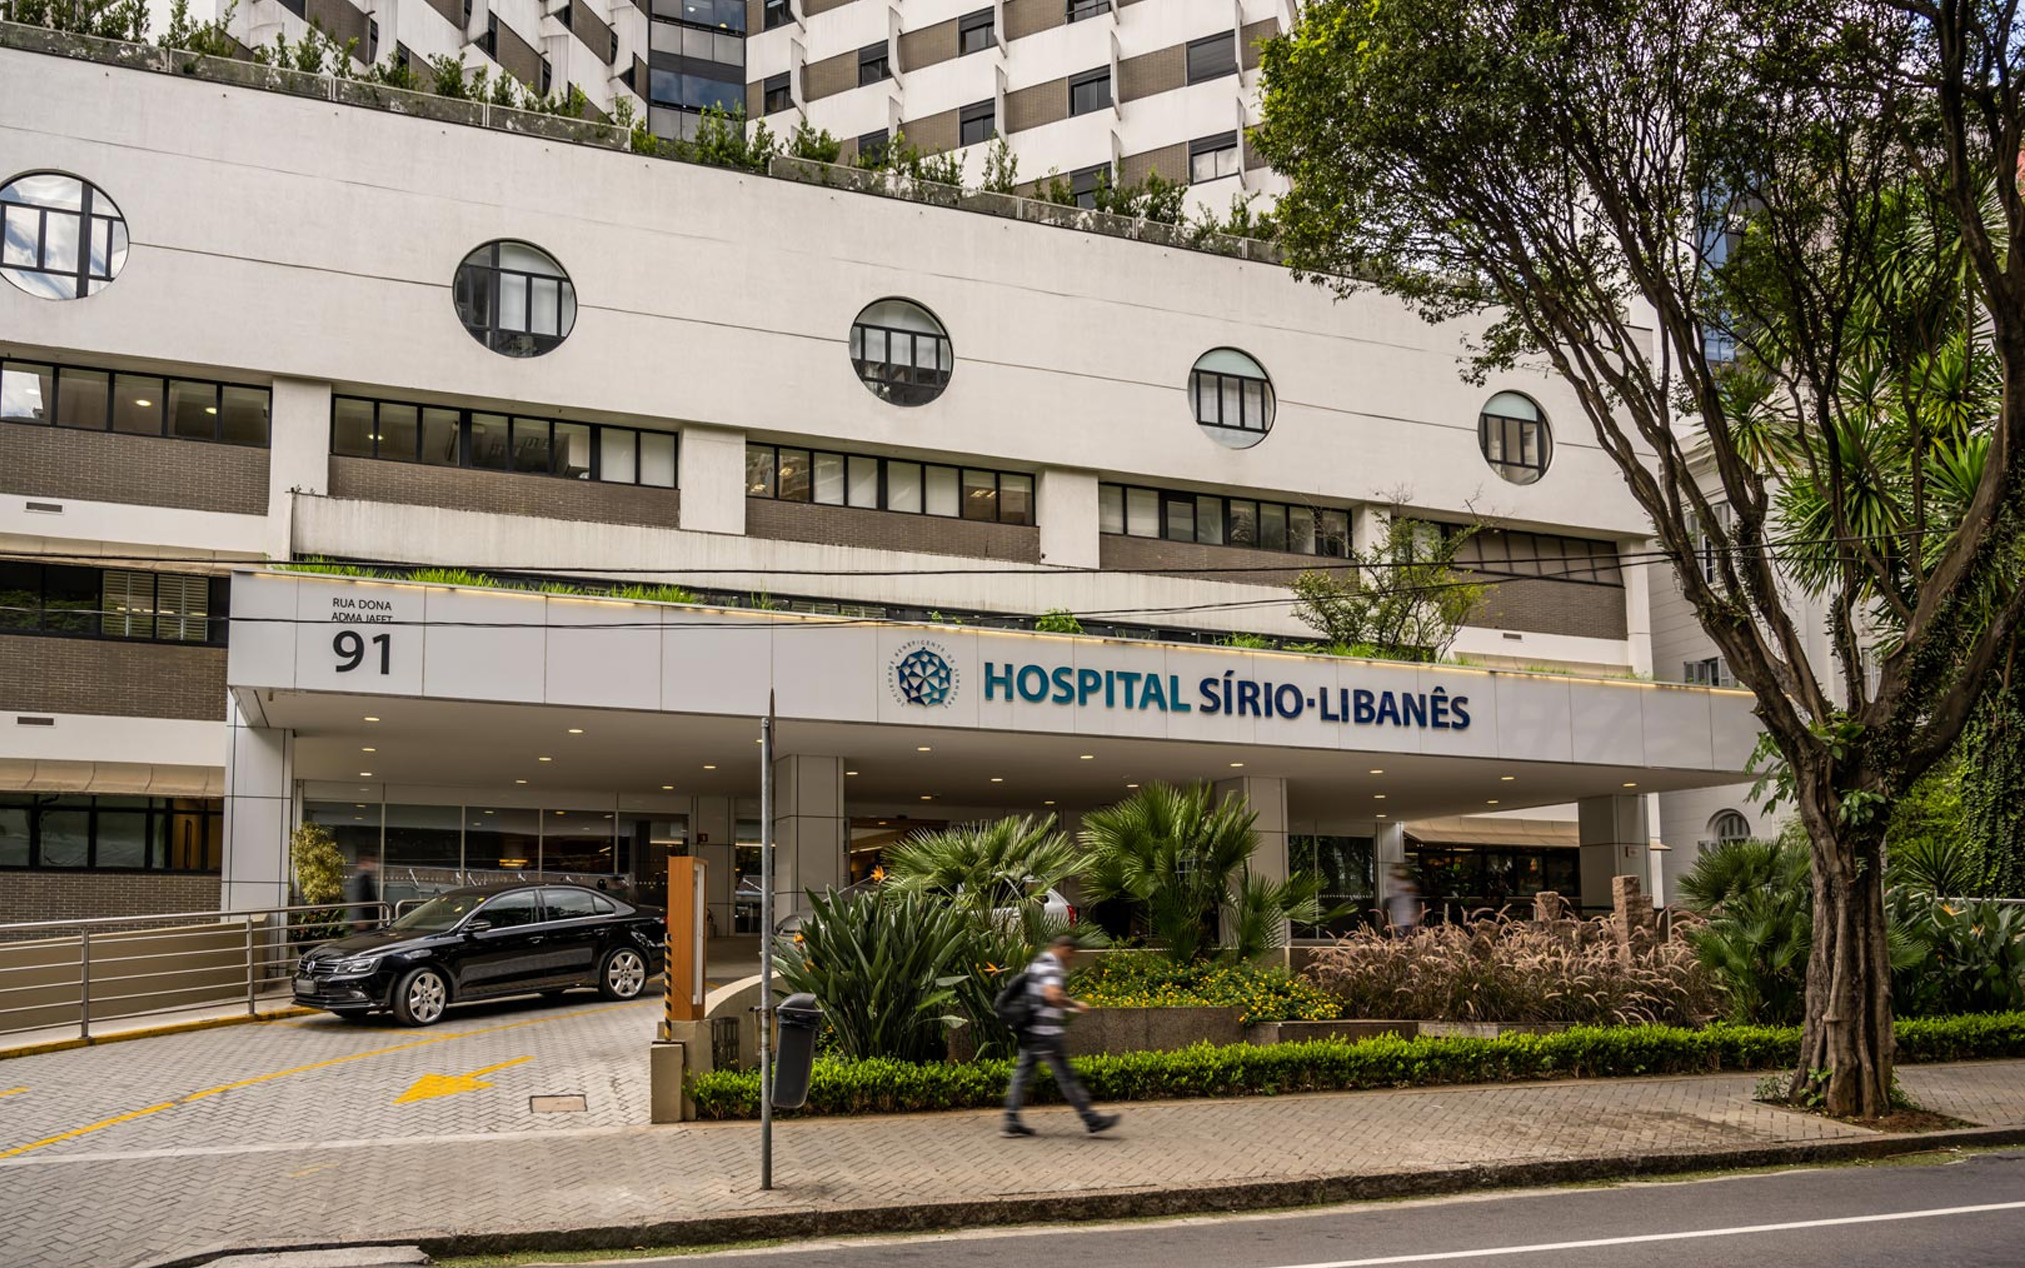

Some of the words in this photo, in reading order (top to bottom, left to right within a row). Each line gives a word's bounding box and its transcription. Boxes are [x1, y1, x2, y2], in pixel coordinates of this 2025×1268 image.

[331, 612, 362, 623] ADMA
[333, 597, 355, 608] RUA
[358, 600, 392, 611] DONA
[333, 630, 390, 675] 91
[984, 662, 1191, 713] HOSPITAL
